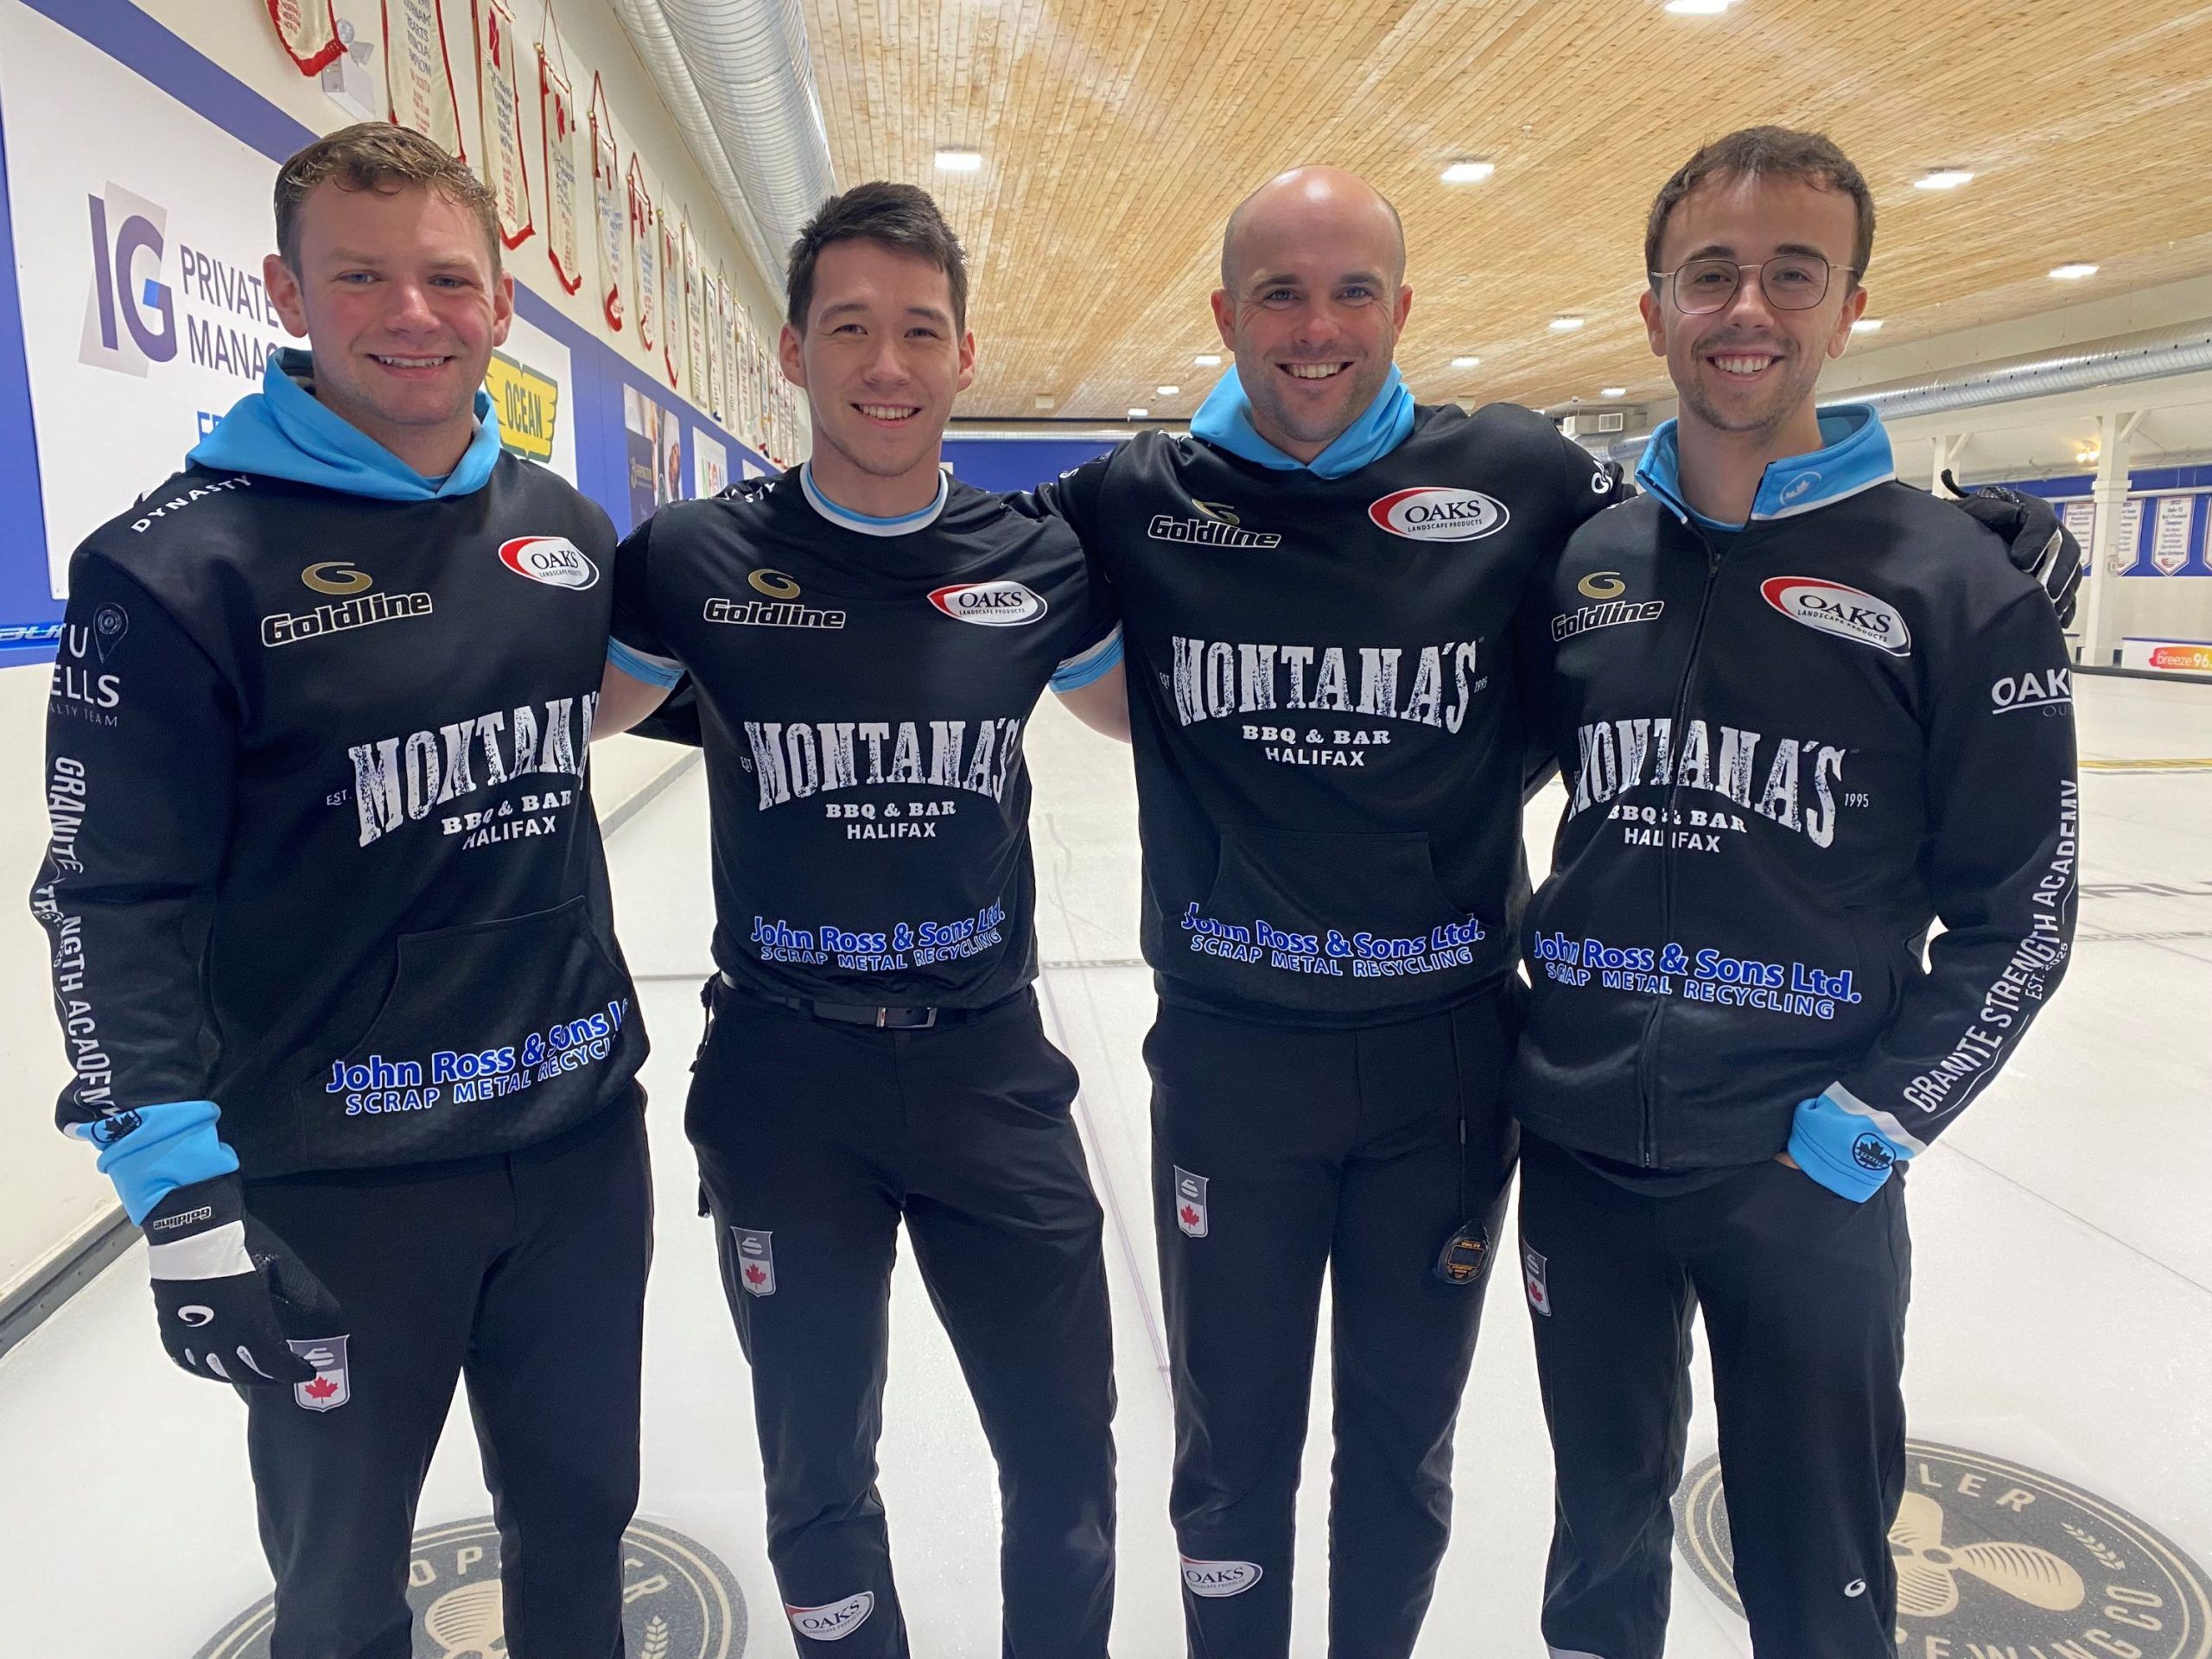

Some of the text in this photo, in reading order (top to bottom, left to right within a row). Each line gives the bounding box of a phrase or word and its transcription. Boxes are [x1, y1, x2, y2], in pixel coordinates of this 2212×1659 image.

[88, 193, 177, 362] IG
[505, 379, 543, 439] OCEAN
[131, 475, 252, 533] DYNASTY
[1404, 499, 1482, 524] OAKS
[1147, 514, 1281, 549] Goldline
[1408, 518, 1483, 532] LANDSCAPE PRODUCTS
[531, 550, 579, 570] OAKS
[703, 597, 847, 629] Goldline
[958, 591, 1023, 608] OAKS
[1799, 594, 1891, 633] OAKS
[261, 592, 433, 647] Goldline
[1552, 601, 1665, 642] Goldline
[1797, 609, 1888, 643] LANDSCAPE PRODUCTS
[2157, 652, 2193, 666] breeze
[1173, 635, 1476, 734] MONTANA'S
[1992, 667, 2071, 706] OAK
[84, 708, 118, 727] TEAM
[1242, 725, 1391, 745] BBQ & BAR
[744, 717, 1021, 811] MONTANA'S
[1264, 747, 1365, 766] HALIFAX
[48, 756, 86, 874] GRANITE
[327, 790, 352, 805] EST.
[498, 800, 513, 817] &
[521, 790, 572, 812] BAR
[825, 800, 957, 820] BBQ & BAR
[1844, 792, 1869, 808] 1995
[462, 815, 556, 850] HALIFAX
[847, 822, 937, 840] HALIFAX
[1608, 804, 1656, 824] BBQ
[1690, 810, 1747, 833] BAR
[1624, 827, 1721, 853] HALIFAX
[33, 885, 86, 992] TRNGTH
[751, 895, 1006, 953] John Ross & Sons Ltd.
[1181, 901, 1486, 960] John Ross & Sons Ltd.
[760, 927, 1002, 971] SCRAP METAL RECYCLING
[1191, 934, 1473, 978] SCRAP METAL RECYCLING
[1534, 931, 1863, 1004] John Ross & Sons Ltd.
[2024, 942, 2069, 1001] EST. 2025
[1602, 971, 1673, 995] METAL
[1683, 979, 1835, 1020] RECYCLING
[1903, 1025, 2003, 1114] GRANITE
[1980, 913, 2061, 1028] STRENGTH
[327, 1055, 422, 1093] John
[432, 1046, 516, 1083] Ross
[522, 1032, 546, 1066] &
[548, 1013, 610, 1055] Sons
[346, 1087, 441, 1116] SCRAP
[453, 1072, 531, 1104] METAL
[153, 1205, 212, 1230] Goldline
[1186, 1567, 1244, 1584] OAKS
[802, 1599, 860, 1630] OAKS
